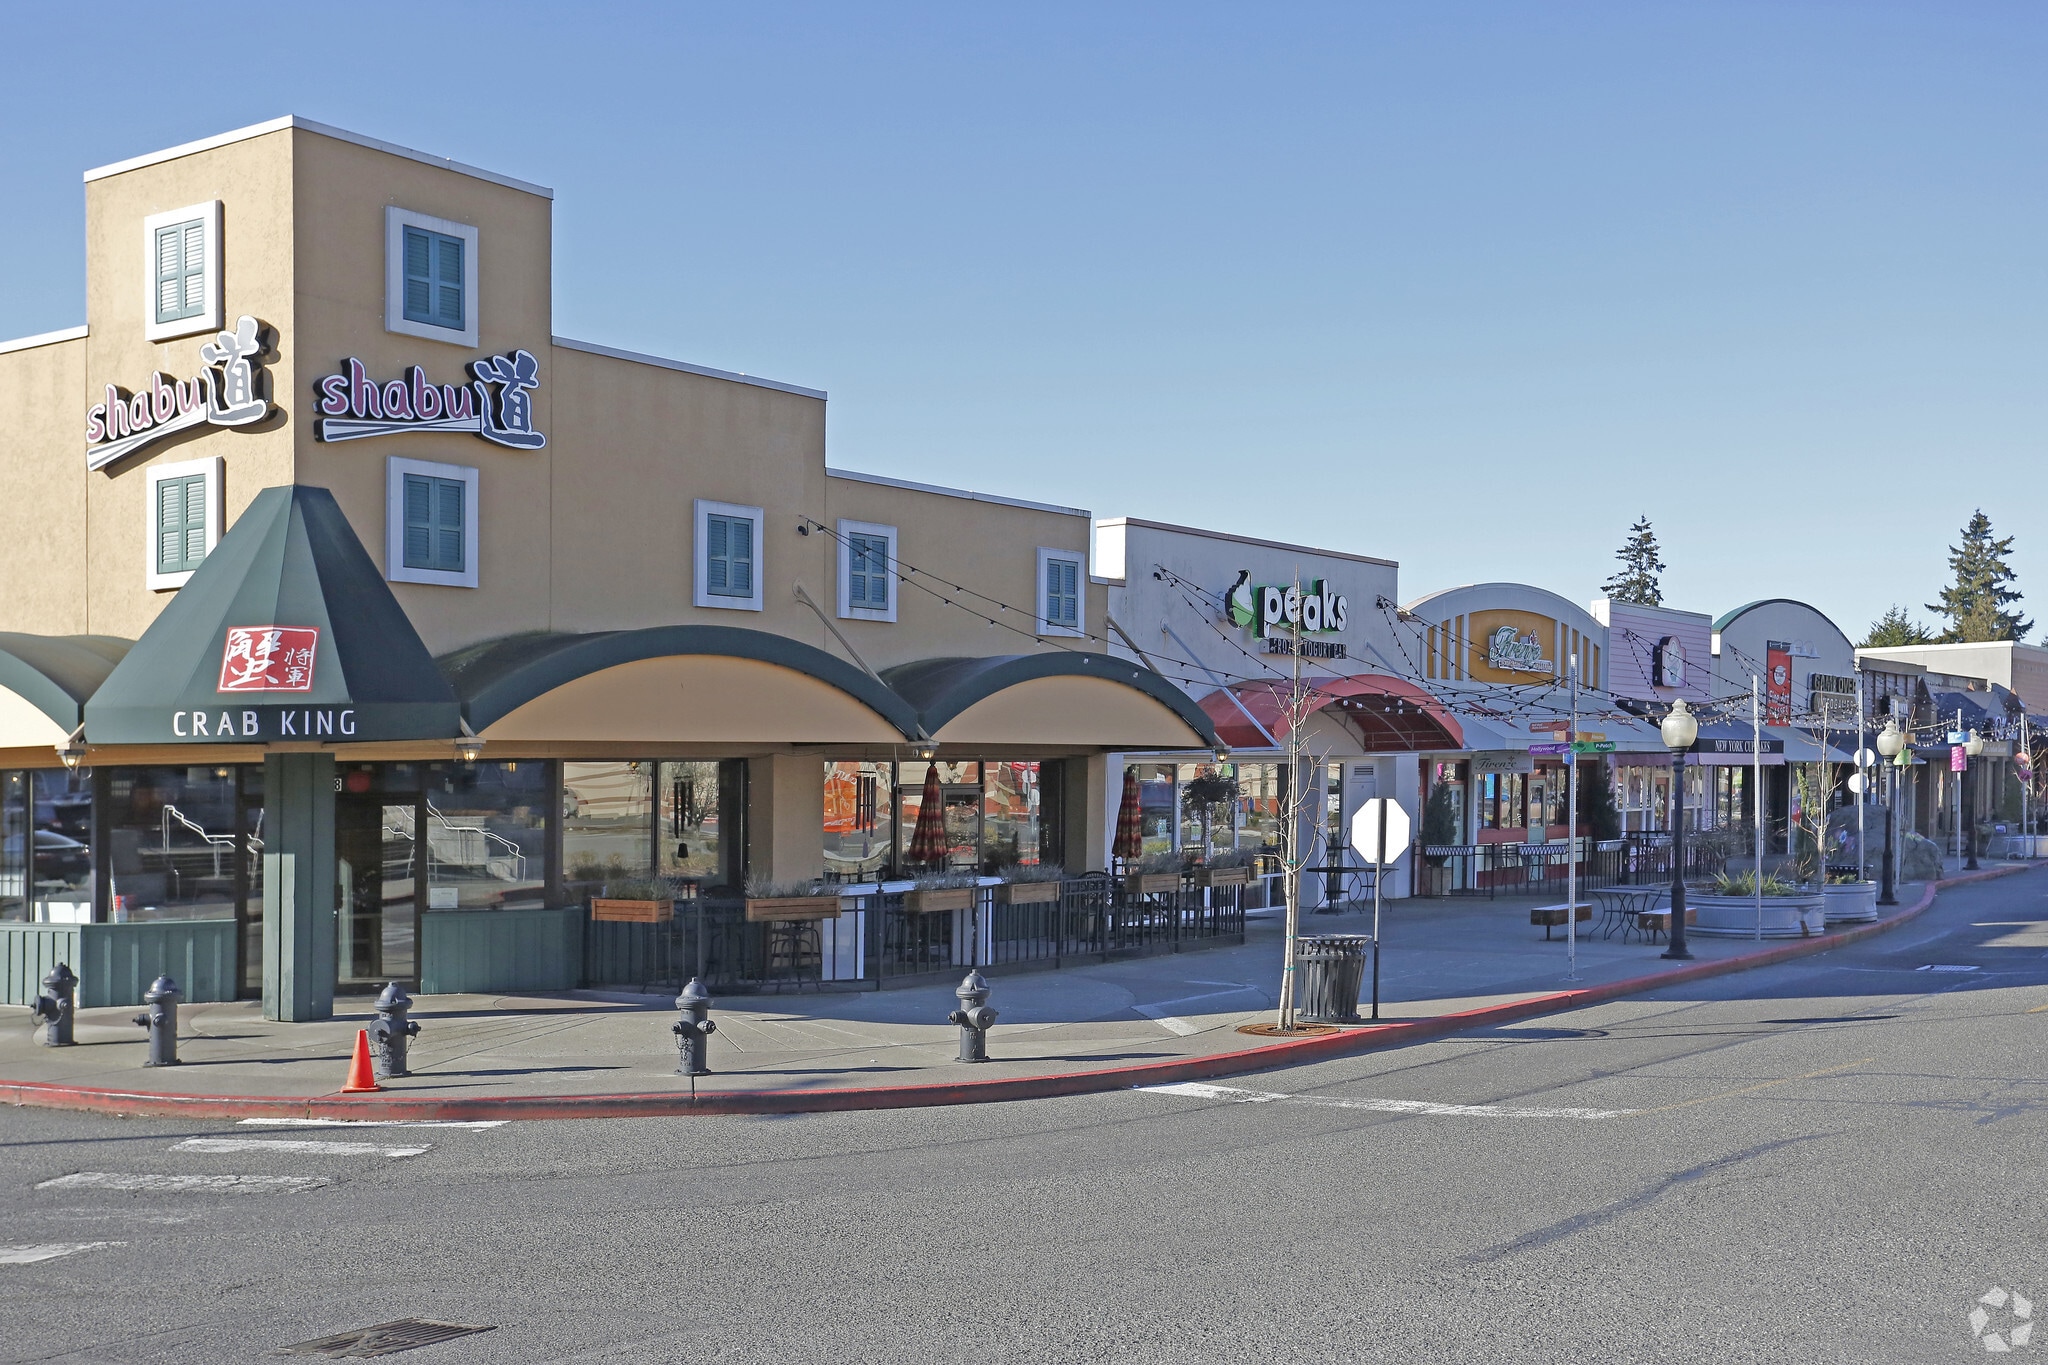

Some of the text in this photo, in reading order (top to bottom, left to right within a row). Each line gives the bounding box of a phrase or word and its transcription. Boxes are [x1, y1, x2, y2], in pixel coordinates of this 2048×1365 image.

[87, 315, 267, 443] shabu 道
[322, 349, 546, 450] shabu 道
[1264, 579, 1348, 638] peaks
[1814, 674, 1856, 694] GAME OVER
[173, 710, 355, 737] CRAB KING
[1715, 740, 1728, 752] NEW
[1728, 740, 1743, 752] YORK
